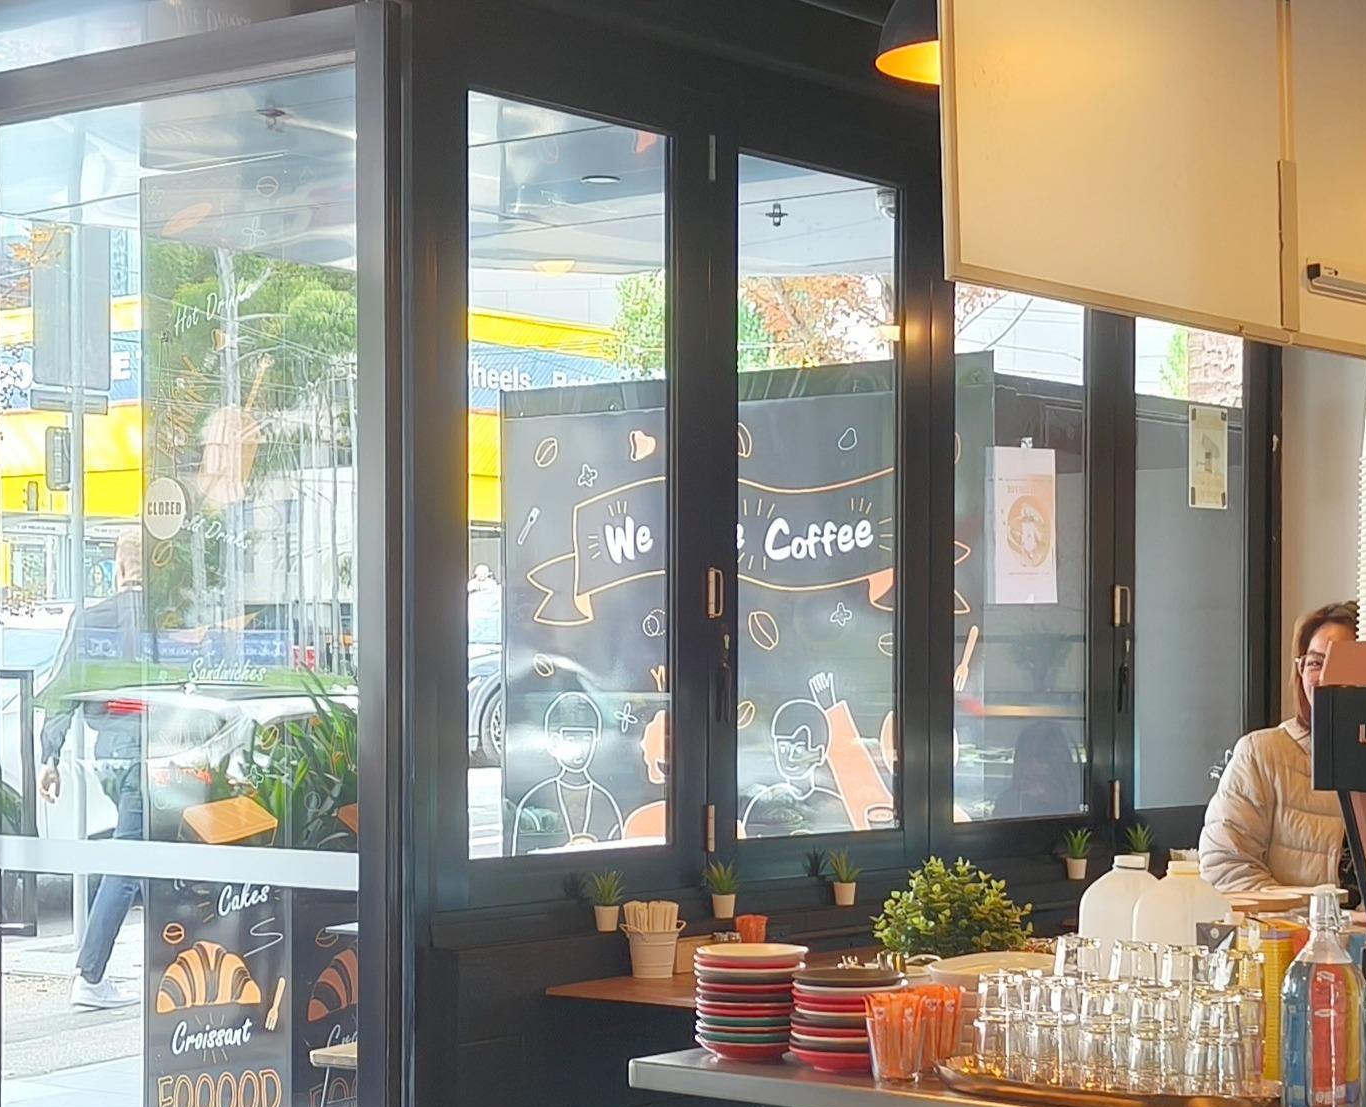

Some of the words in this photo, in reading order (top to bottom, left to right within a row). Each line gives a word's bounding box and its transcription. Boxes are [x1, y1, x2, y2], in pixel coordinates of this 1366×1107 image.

[175, 306, 200, 336] Hot
[469, 359, 532, 390] heels
[147, 502, 181, 515] CLOSED
[604, 516, 653, 564] We
[764, 517, 874, 561] Coffee
[188, 657, 267, 682] Sandwiches
[218, 880, 269, 916] Cakes
[172, 1017, 252, 1055] Croissant
